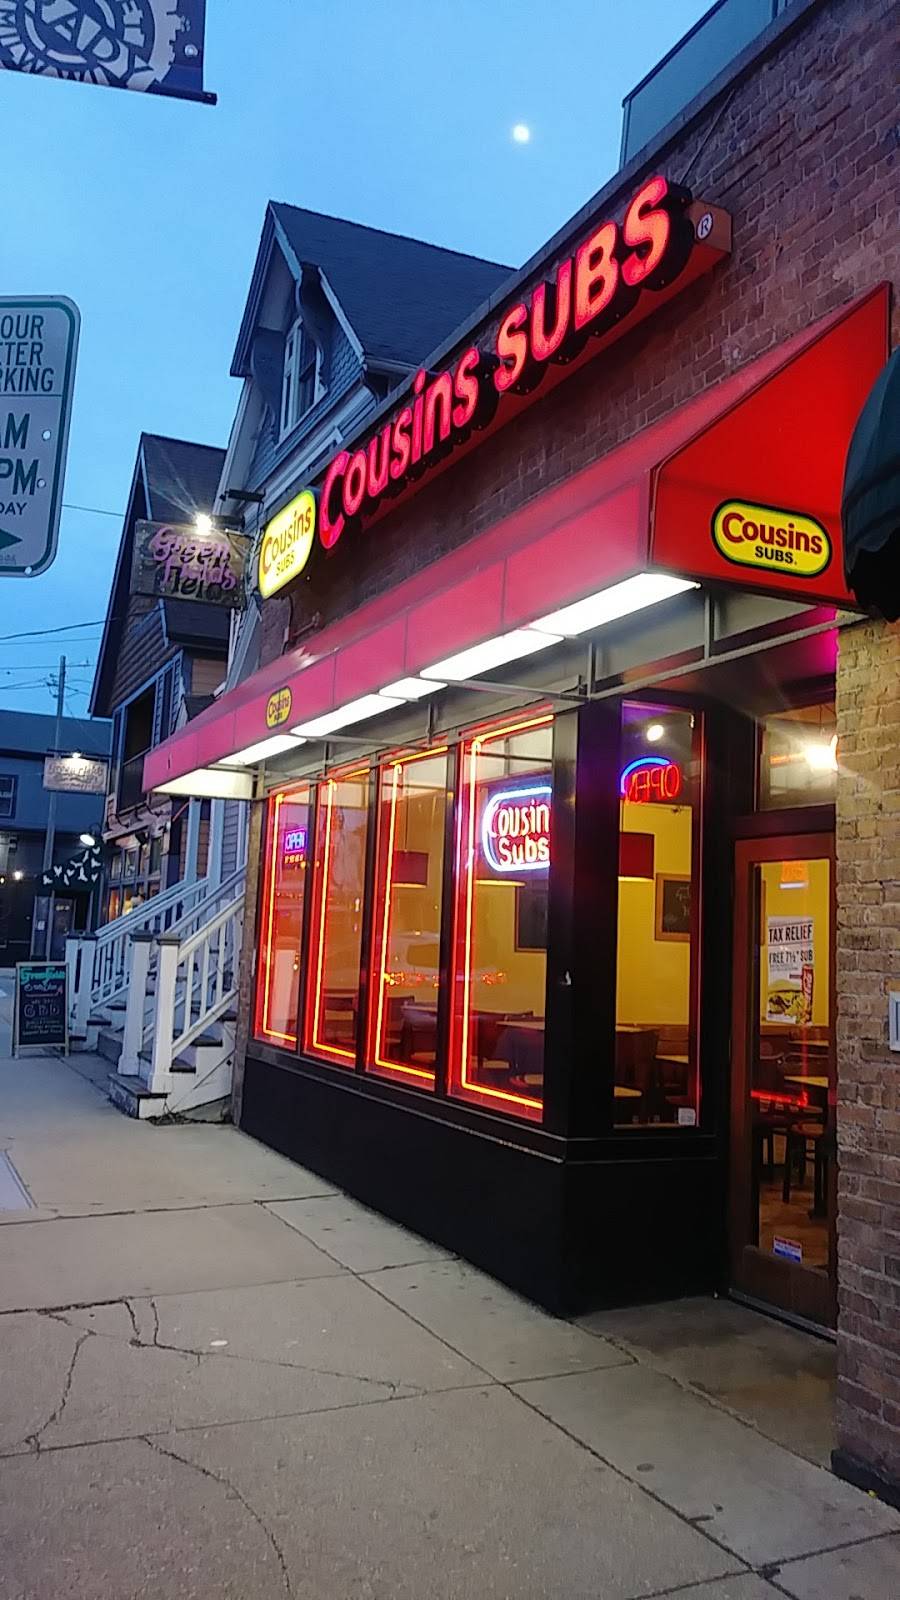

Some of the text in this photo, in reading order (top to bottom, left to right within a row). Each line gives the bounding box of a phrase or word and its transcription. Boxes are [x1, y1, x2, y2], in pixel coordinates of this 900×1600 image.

[0, 341, 43, 366] TER
[318, 346, 481, 550] Cousins
[494, 174, 671, 392] SUBS
[0, 367, 54, 392] KING
[0, 412, 30, 449] M
[262, 506, 312, 575] Cousins
[721, 512, 823, 555] Cousins
[498, 835, 550, 866] Subs
[769, 924, 812, 942] TAX RELIEF
[769, 951, 785, 964] FREE
[801, 949, 813, 961] SUB
